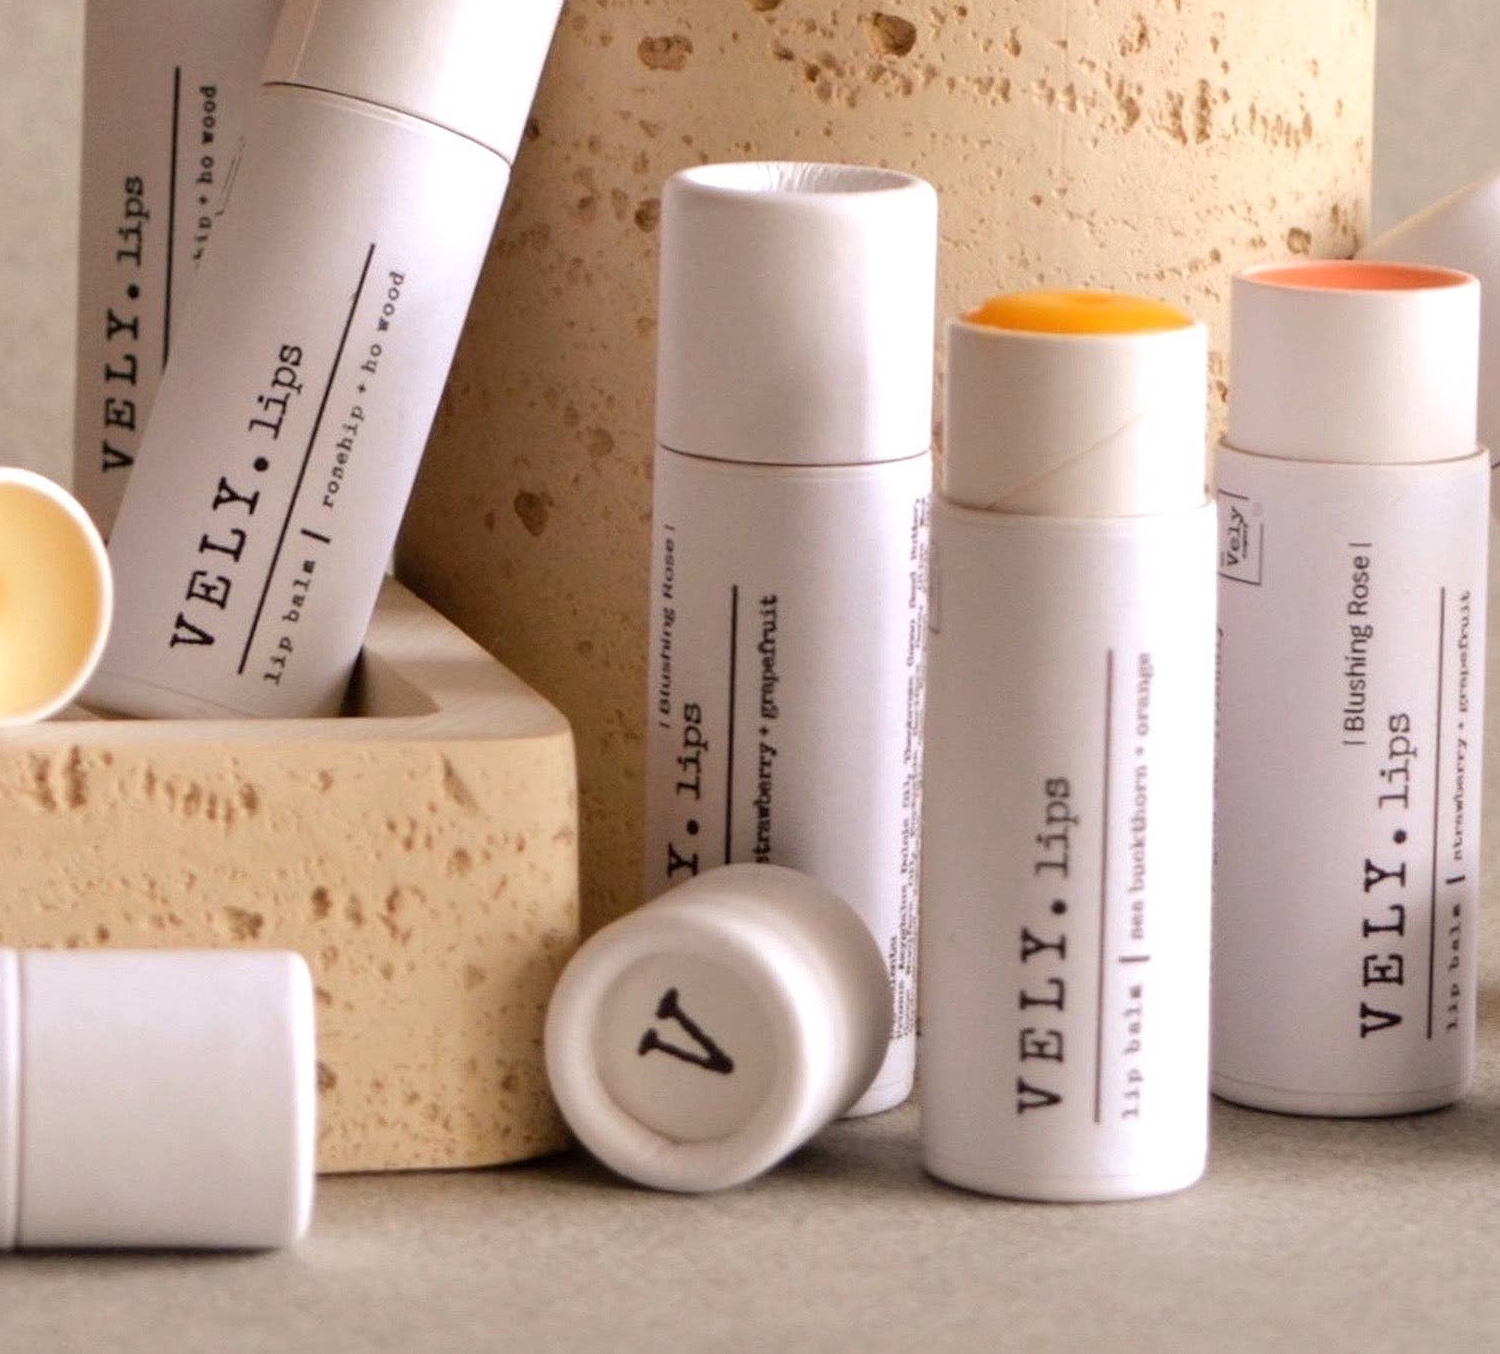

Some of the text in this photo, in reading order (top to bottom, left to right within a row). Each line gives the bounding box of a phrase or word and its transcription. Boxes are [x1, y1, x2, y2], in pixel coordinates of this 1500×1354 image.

[195, 156, 213, 184] ho
[199, 85, 217, 144] wood
[101, 175, 149, 473] VELY. lips
[169, 343, 303, 650] VELY. lips
[263, 636, 292, 685] lip
[281, 558, 317, 622] balm
[322, 401, 364, 509] rosehip
[360, 343, 382, 376] ho
[377, 270, 405, 333] wood
[658, 537, 677, 716] Blushing Rose
[757, 594, 779, 720] grapefruit
[1342, 554, 1373, 732] Blushing Rose
[1458, 589, 1472, 714] grapefruit
[675, 701, 709, 802] lips
[1134, 651, 1155, 738] orange
[1127, 764, 1149, 893] buckthorn
[1451, 736, 1469, 861] strawberry
[1359, 712, 1417, 1039] VELY. lips
[1017, 776, 1079, 1114] VELY. lips
[637, 987, 734, 1075] V
[1122, 983, 1144, 1055] balm
[1446, 982, 1462, 1034] lip
[1121, 1068, 1143, 1119] lip
